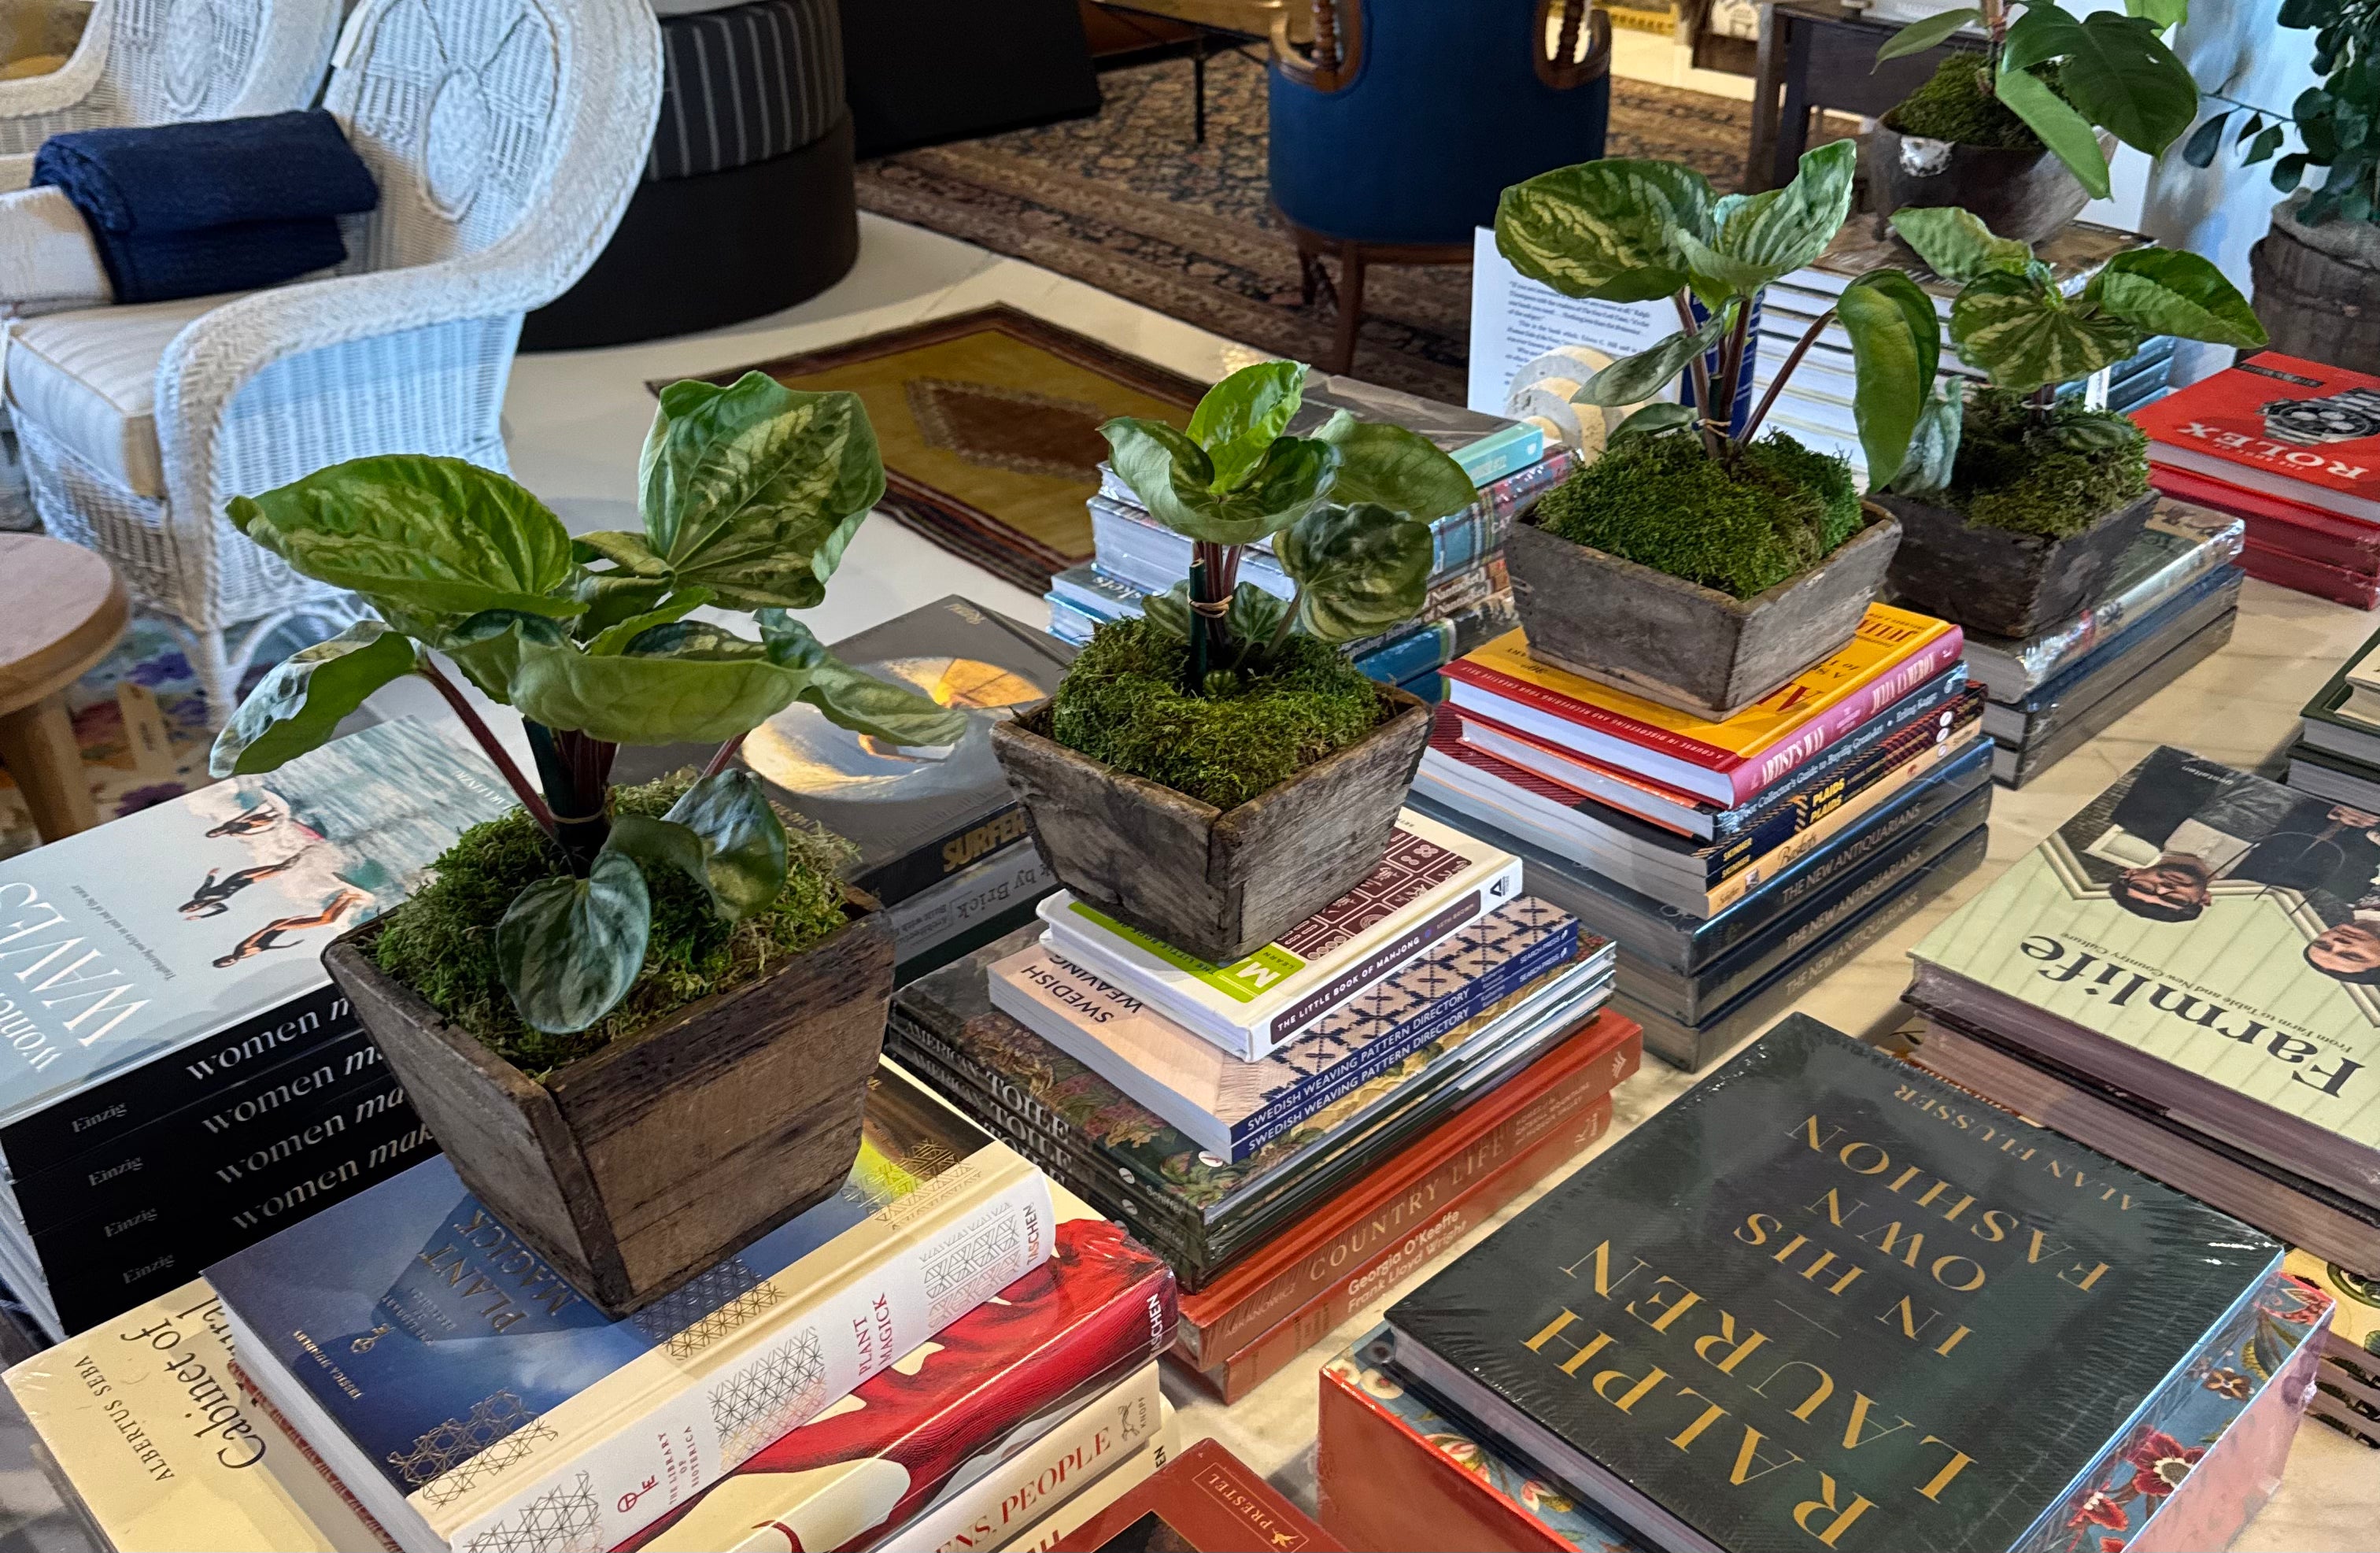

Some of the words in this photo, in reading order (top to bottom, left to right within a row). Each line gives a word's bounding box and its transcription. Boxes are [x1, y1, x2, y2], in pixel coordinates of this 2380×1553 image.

[2176, 422, 2369, 479] ROLEX
[1091, 576, 1141, 600] skets
[1803, 725, 1825, 757] WAY
[1810, 793, 1842, 823] PLAIDS
[1813, 777, 1846, 807] PLAIDS
[1013, 868, 1037, 890] by
[1783, 882, 1805, 904] THE
[1805, 861, 1835, 889] NEW
[1835, 802, 1921, 867] ANTIQUARIANS
[955, 882, 1010, 919] Brick
[1786, 927, 1807, 950] THE
[1810, 907, 1836, 934] NEW
[1837, 845, 1921, 910] ANTIQUARIANS
[1262, 951, 1295, 970] LEARN
[1787, 974, 1808, 996] THE
[1811, 953, 1835, 977] NEW
[1835, 890, 1918, 957] ANTIQUARIANS
[2060, 932, 2108, 954] Culture
[2113, 951, 2164, 977] Country
[1021, 965, 1114, 1024] SWEDISH
[1277, 1014, 1296, 1032] THE
[1299, 993, 1331, 1019] LITTLE
[1333, 975, 1358, 997] BOOK
[1362, 966, 1373, 978] OF
[1376, 936, 1420, 969] MAHJONG
[2165, 974, 2193, 989] New
[2193, 985, 2222, 998] and
[2223, 996, 2258, 1015] Table
[186, 1010, 320, 1080] women
[1247, 1091, 1301, 1132] SWEDISH
[1303, 1059, 1358, 1096] WEAVING
[1361, 1026, 1410, 1063] PATTERN
[1412, 987, 1470, 1030] DIRECTORY
[1520, 946, 1543, 964] SEARCH
[1542, 935, 1561, 949] PRESS
[2020, 935, 2365, 1099] Farmlife
[2260, 1011, 2276, 1022] to
[2278, 1018, 2314, 1037] Farm
[2316, 1033, 2352, 1053] From
[906, 1023, 978, 1077] AMERICAN
[986, 1070, 1070, 1140] TOILE
[1249, 1110, 1303, 1151] SWEDISH
[1304, 1078, 1358, 1116] WEAVING
[1361, 1045, 1411, 1082] PATTERN
[1413, 1006, 1470, 1048] DIRECTORY
[1519, 965, 1542, 983] SEARCH
[1542, 953, 1560, 968] PRESS
[72, 1103, 128, 1133] Einzig
[201, 1066, 336, 1133] women
[1893, 1083, 2037, 1162] FLUSSER
[215, 1115, 346, 1183] women
[990, 1101, 1072, 1168] TOILE
[88, 1156, 143, 1187] Einzig
[232, 1159, 360, 1229] women
[368, 1122, 435, 1168] mak
[1784, 1113, 2116, 1294] FASHION
[2043, 1159, 2145, 1211] ALAN
[104, 1207, 157, 1237] Einzig
[1026, 1204, 1038, 1266] TASCHEN
[1309, 1178, 1440, 1281] COUNTRY
[1451, 1136, 1504, 1186] LIFE
[1805, 1187, 1987, 1294] OWN
[123, 1254, 175, 1285] Einzig
[453, 1209, 582, 1317] MAGICK
[1347, 1253, 1402, 1296] Georgia
[1403, 1208, 1461, 1256] O'Keeffe
[1347, 1280, 1386, 1314] Frank
[1388, 1254, 1423, 1286] Lloyd
[1426, 1220, 1469, 1257] Wright
[1733, 1212, 1870, 1299] HIS
[417, 1243, 530, 1333] PLANT
[120, 1318, 182, 1351] of
[852, 1315, 873, 1377] PLANT
[872, 1292, 893, 1366] MAGICK
[1148, 1293, 1164, 1355] ASCHEN
[1876, 1293, 1975, 1360] IN
[74, 1355, 113, 1397] SEBA
[1558, 1238, 1980, 1504] LAUREN
[104, 1400, 176, 1481] ALBERTUS
[163, 1352, 266, 1470] Cabinet
[1520, 1305, 1881, 1551] RALPH
[658, 1432, 678, 1488] LIBRARY
[1000, 1424, 1113, 1526] PEOPLE
[1138, 1396, 1147, 1430] KNOPF
[1209, 1473, 1273, 1529] PRESTEL
